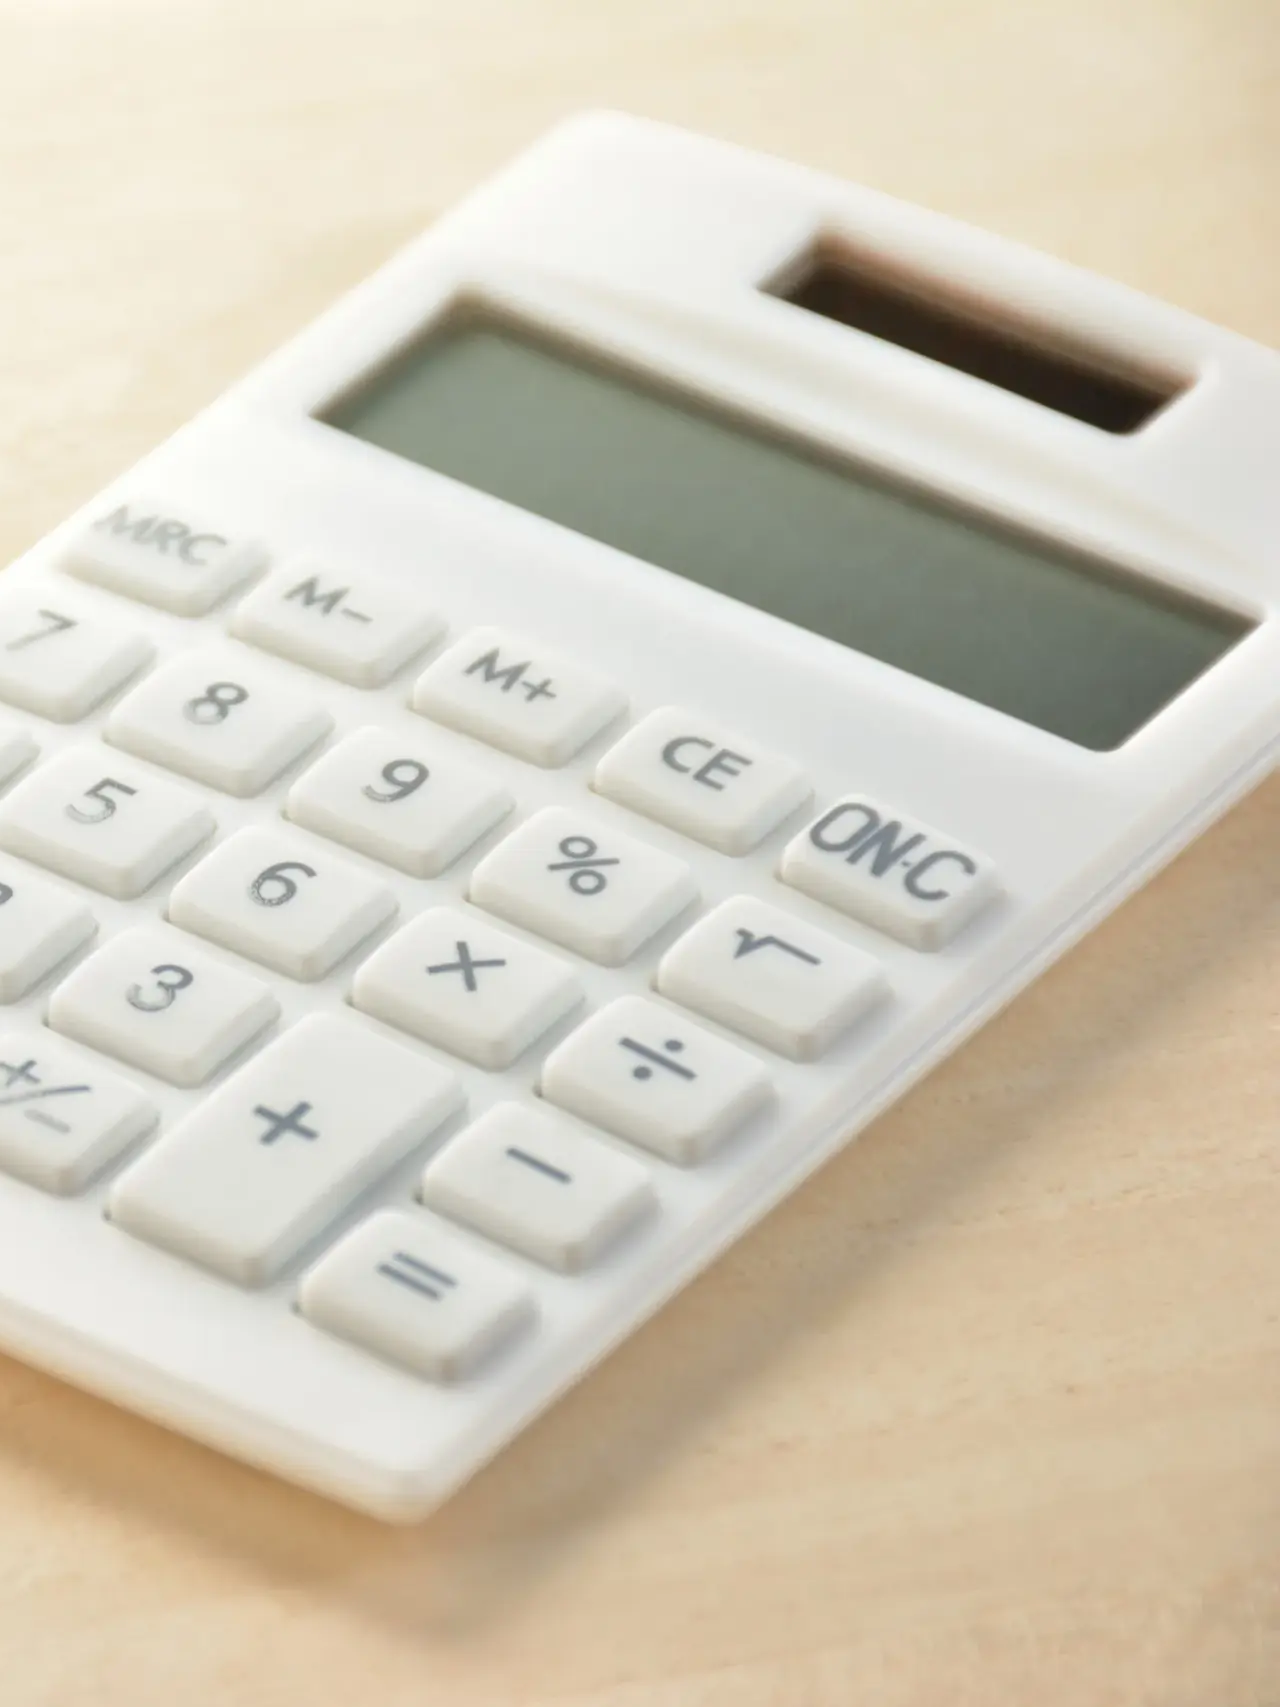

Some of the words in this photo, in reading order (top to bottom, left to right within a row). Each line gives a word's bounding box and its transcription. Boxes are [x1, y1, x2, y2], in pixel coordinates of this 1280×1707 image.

[95, 505, 227, 567] MRC
[283, 576, 374, 625] M-
[5, 609, 79, 652] 7
[462, 647, 558, 704] M+
[183, 681, 250, 726] 8
[361, 758, 430, 805] 9
[661, 736, 753, 792] CE
[66, 777, 139, 825] 5
[248, 861, 318, 909] 6
[546, 835, 621, 897] %
[125, 963, 195, 1014] 3
